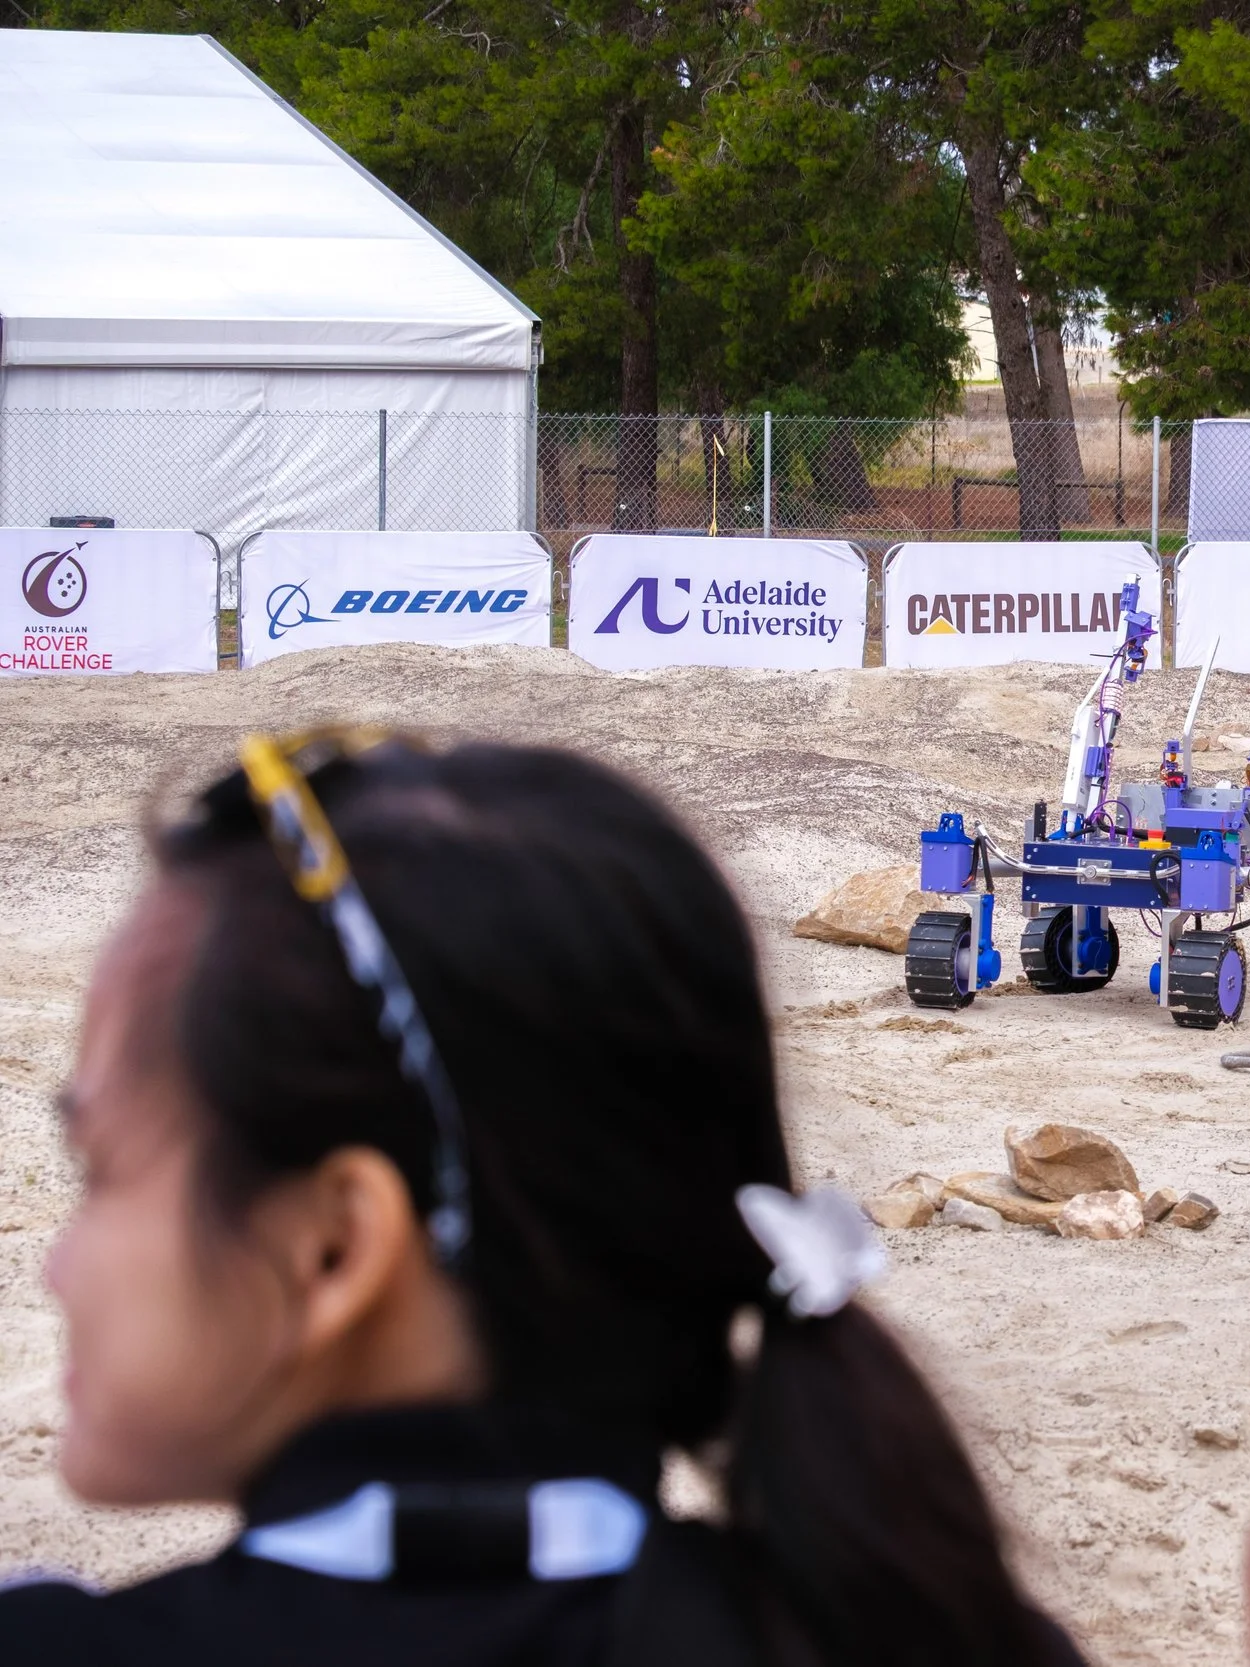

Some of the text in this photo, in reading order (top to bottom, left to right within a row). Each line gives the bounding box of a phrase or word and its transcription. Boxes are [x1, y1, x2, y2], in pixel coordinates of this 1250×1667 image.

[330, 590, 528, 614] BOEING
[702, 579, 827, 606] Adelaide
[702, 609, 843, 643] University
[24, 635, 88, 651] ROVER
[0, 653, 113, 669] CHALLENGE
